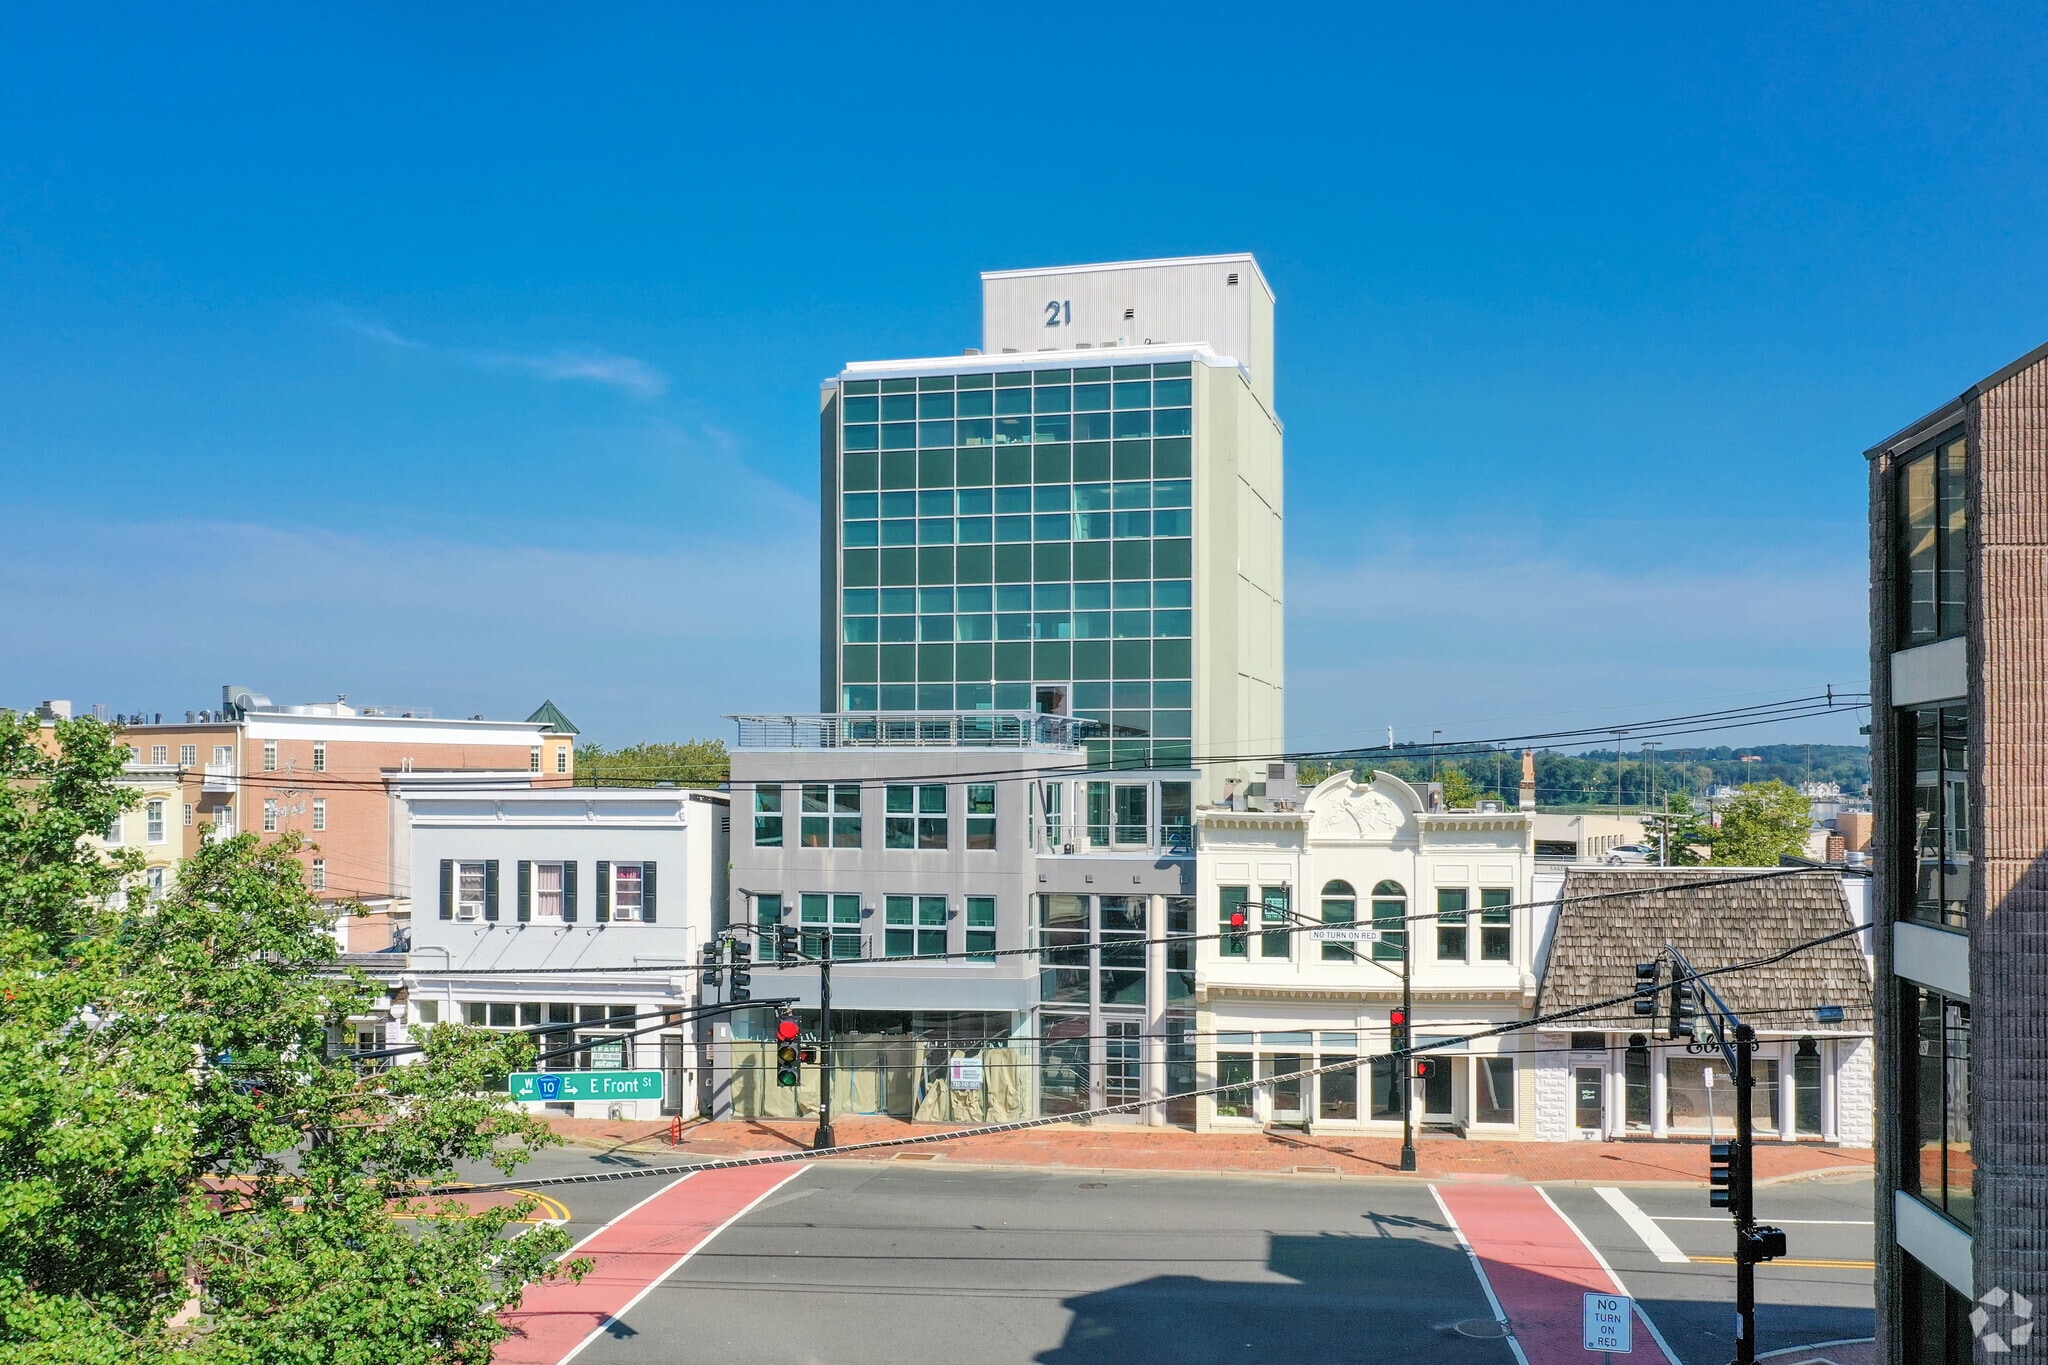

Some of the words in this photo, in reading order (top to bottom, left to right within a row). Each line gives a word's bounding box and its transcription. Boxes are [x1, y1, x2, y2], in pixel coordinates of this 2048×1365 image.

[1045, 300, 1071, 327] 21
[1327, 931, 1347, 939] TURN
[1361, 932, 1377, 940] RED
[525, 1078, 534, 1089] W
[542, 1082, 555, 1093] 10
[564, 1077, 571, 1088] E
[590, 1078, 599, 1093] E
[603, 1078, 639, 1093] Front
[642, 1077, 652, 1087] St
[1597, 1299, 1617, 1311] NO
[1594, 1312, 1621, 1324] TURN
[1600, 1325, 1615, 1335] ON
[1597, 1336, 1617, 1347] RED
